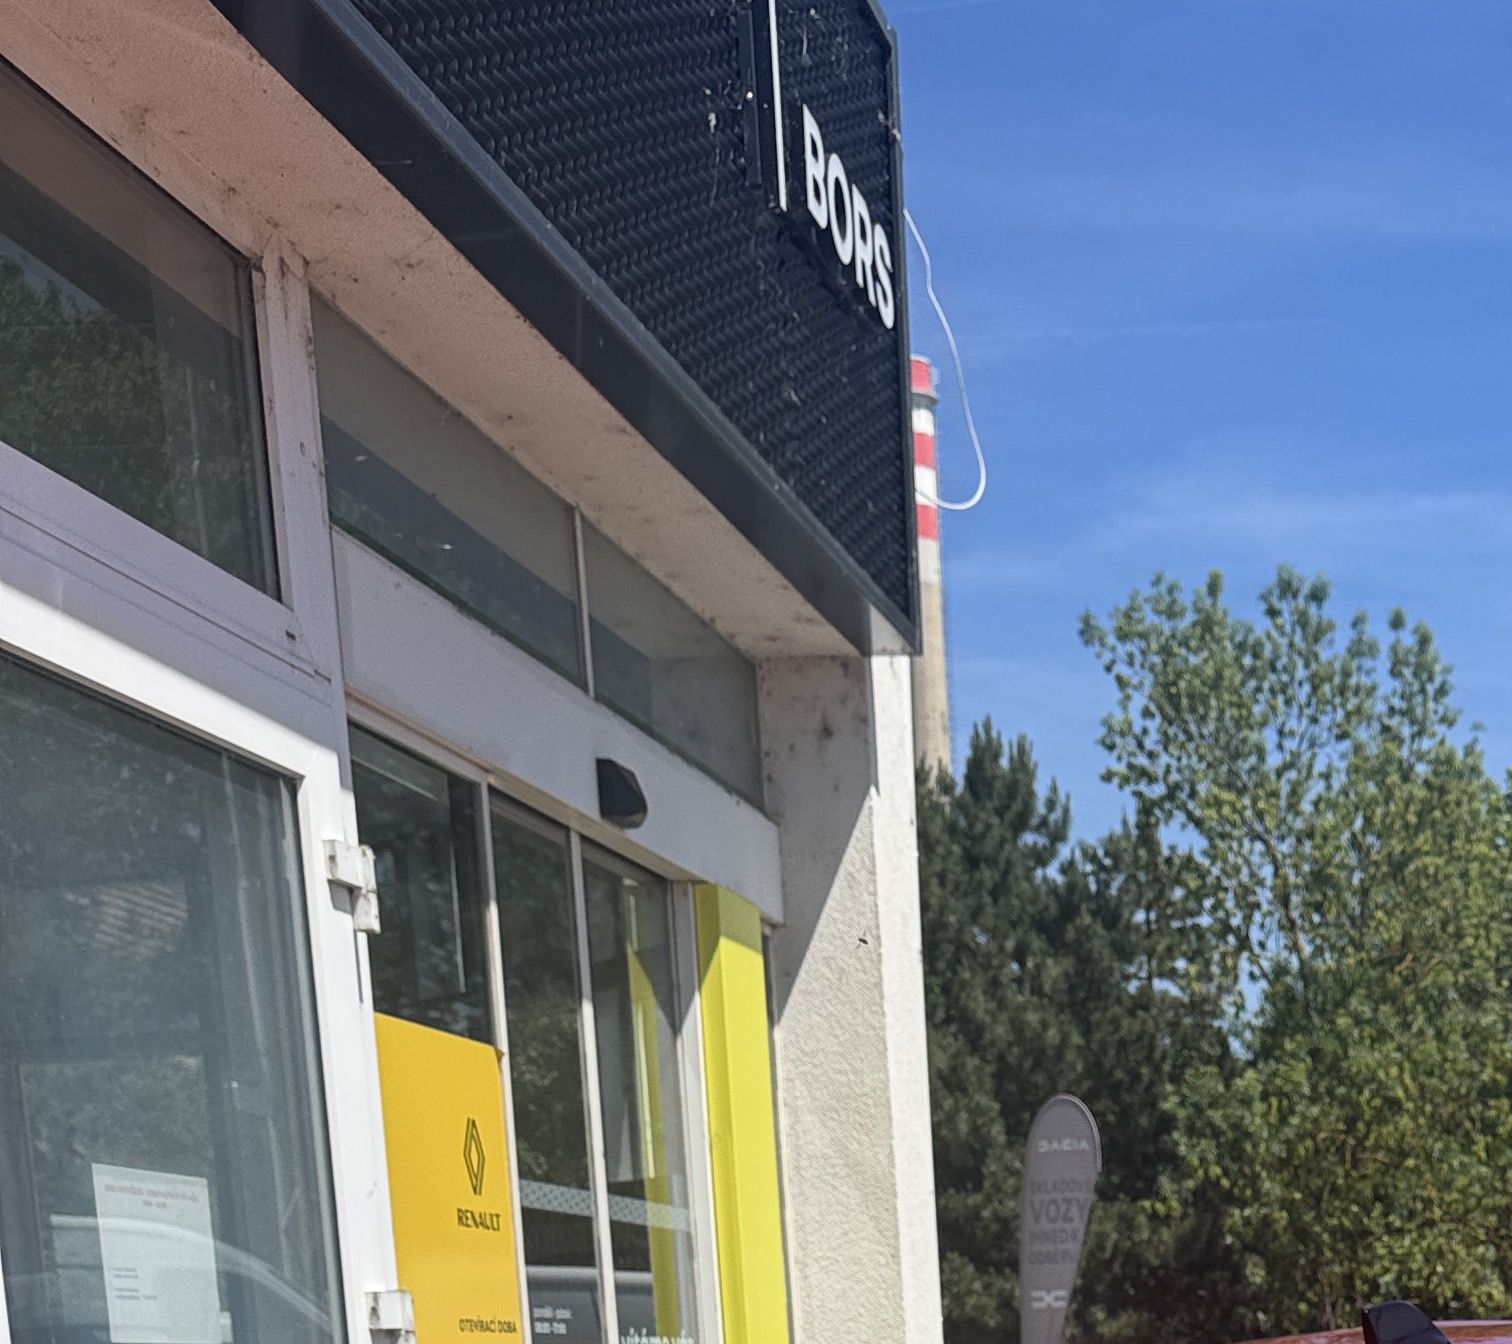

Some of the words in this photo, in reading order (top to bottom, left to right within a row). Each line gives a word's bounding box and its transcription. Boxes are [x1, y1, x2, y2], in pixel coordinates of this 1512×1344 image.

[802, 104, 895, 330] BORS
[457, 1207, 501, 1232] RENAULT
[1029, 1198, 1089, 1224] VOZY
